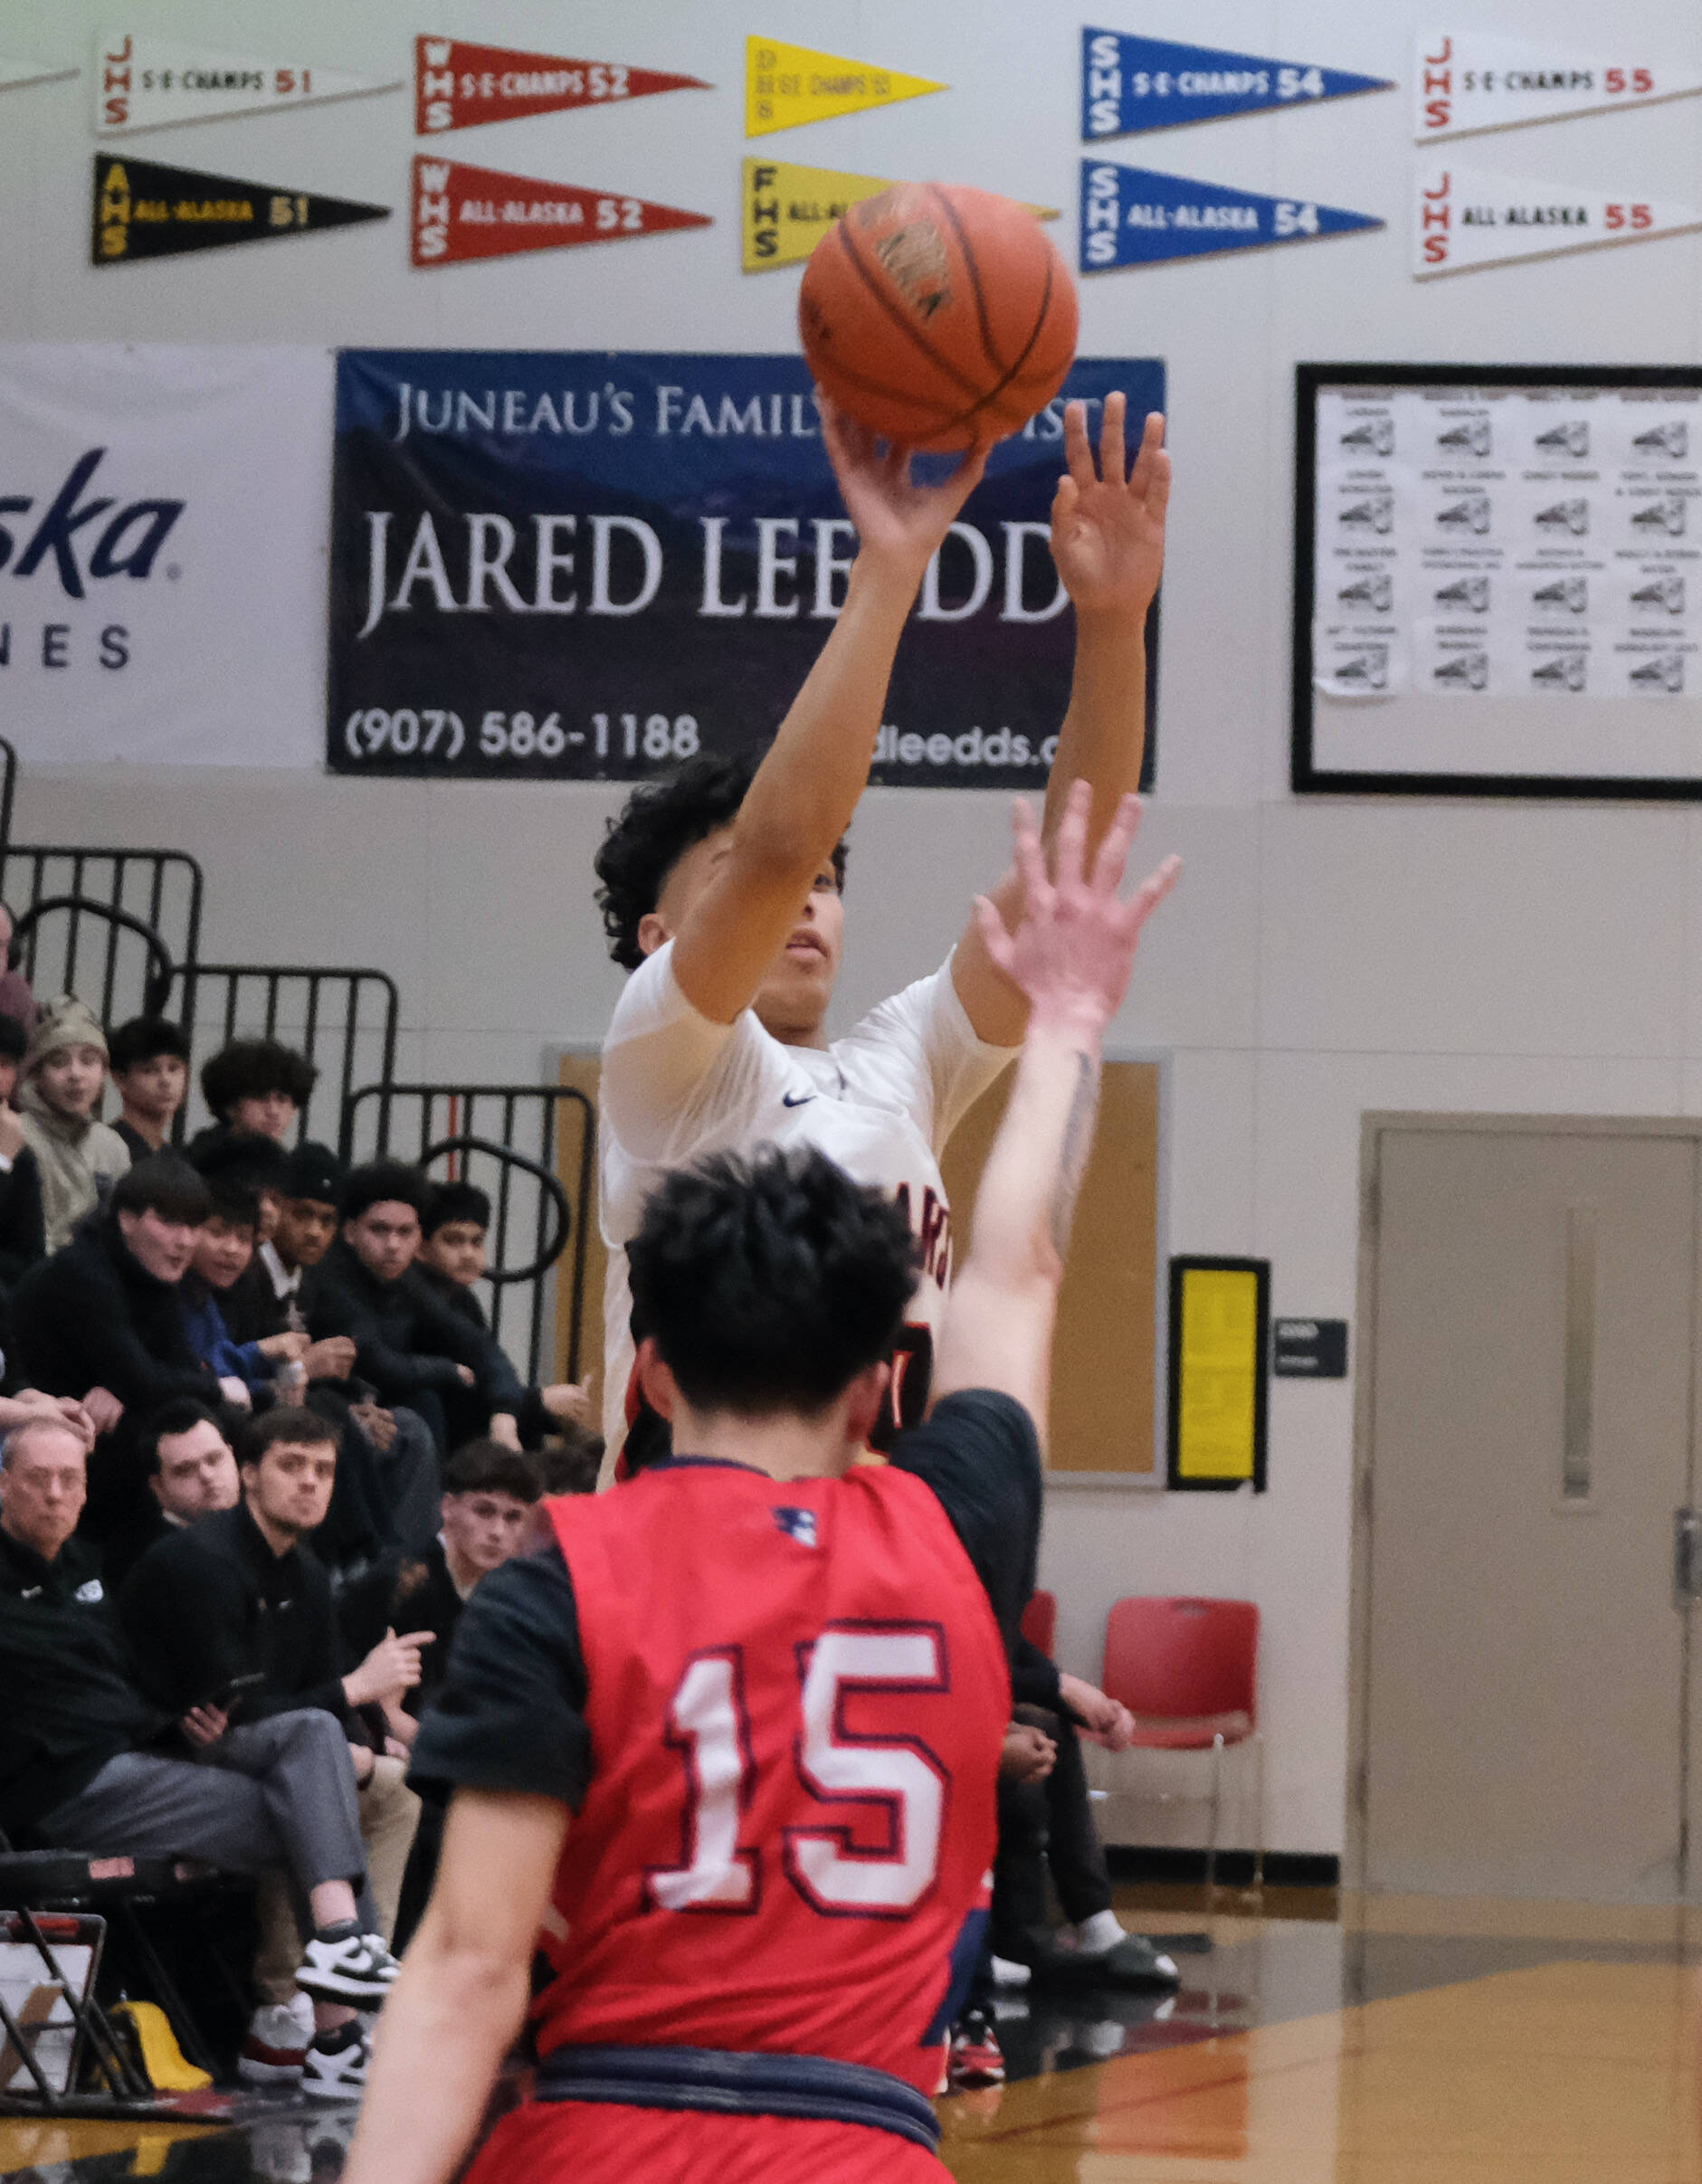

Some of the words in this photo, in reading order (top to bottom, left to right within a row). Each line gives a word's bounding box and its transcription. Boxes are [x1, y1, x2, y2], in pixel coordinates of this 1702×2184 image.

[104, 33, 132, 125] JHS
[275, 68, 311, 93] 51
[423, 41, 453, 129] WHS
[589, 65, 632, 99] 52
[1089, 35, 1122, 133] SHS
[1275, 66, 1325, 99] 54
[1424, 36, 1452, 128] JHS
[1603, 67, 1655, 93] 55
[100, 162, 131, 257] AHS
[270, 194, 309, 227] 51
[419, 162, 451, 259] WHS
[594, 198, 644, 230] 52
[753, 166, 779, 259] FHS
[1086, 166, 1120, 264] SHS
[1272, 201, 1320, 235] 54
[1422, 171, 1452, 263] JHS
[1602, 203, 1655, 231] 55
[395, 382, 633, 443] JUNEAU'S
[655, 385, 818, 438] FAMIL
[357, 510, 663, 639] JARED
[345, 707, 465, 760] (907)
[480, 710, 701, 760] 586-1188
[642, 1618, 954, 1921] 15
